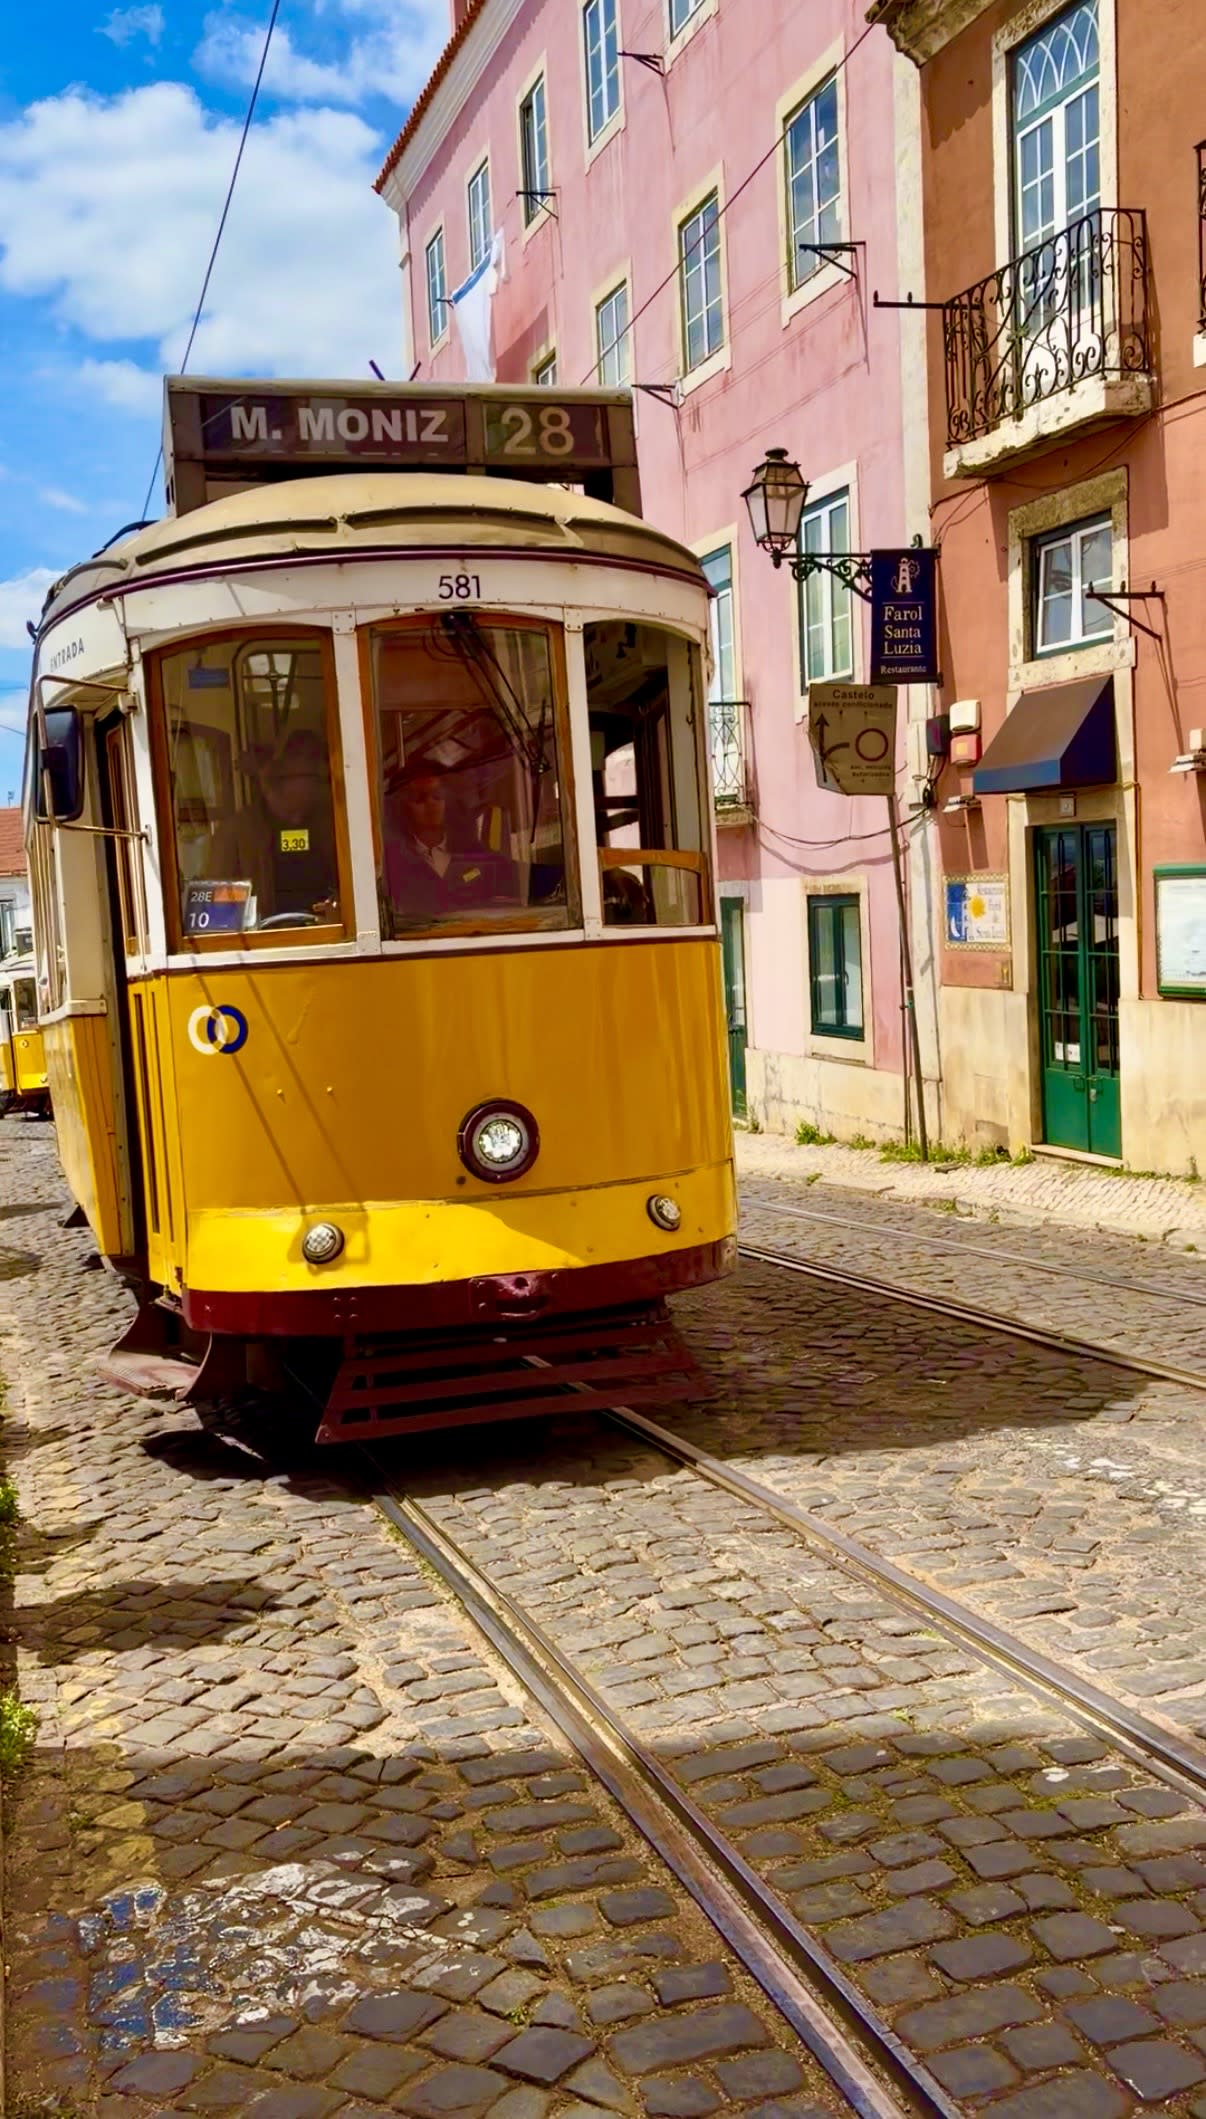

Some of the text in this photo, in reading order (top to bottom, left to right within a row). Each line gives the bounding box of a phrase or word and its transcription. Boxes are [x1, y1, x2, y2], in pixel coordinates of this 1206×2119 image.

[230, 406, 449, 443] M. MONIZ
[501, 407, 575, 455] 28
[438, 574, 480, 600] 581
[883, 605, 922, 621] Farol
[884, 625, 921, 639] Santa
[50, 637, 85, 673] ENTRADA
[883, 641, 922, 655] Luzia
[880, 665, 927, 674] Restaurante
[832, 689, 875, 700] Castelo
[190, 891, 213, 903] 28E
[189, 912, 210, 928] 10
